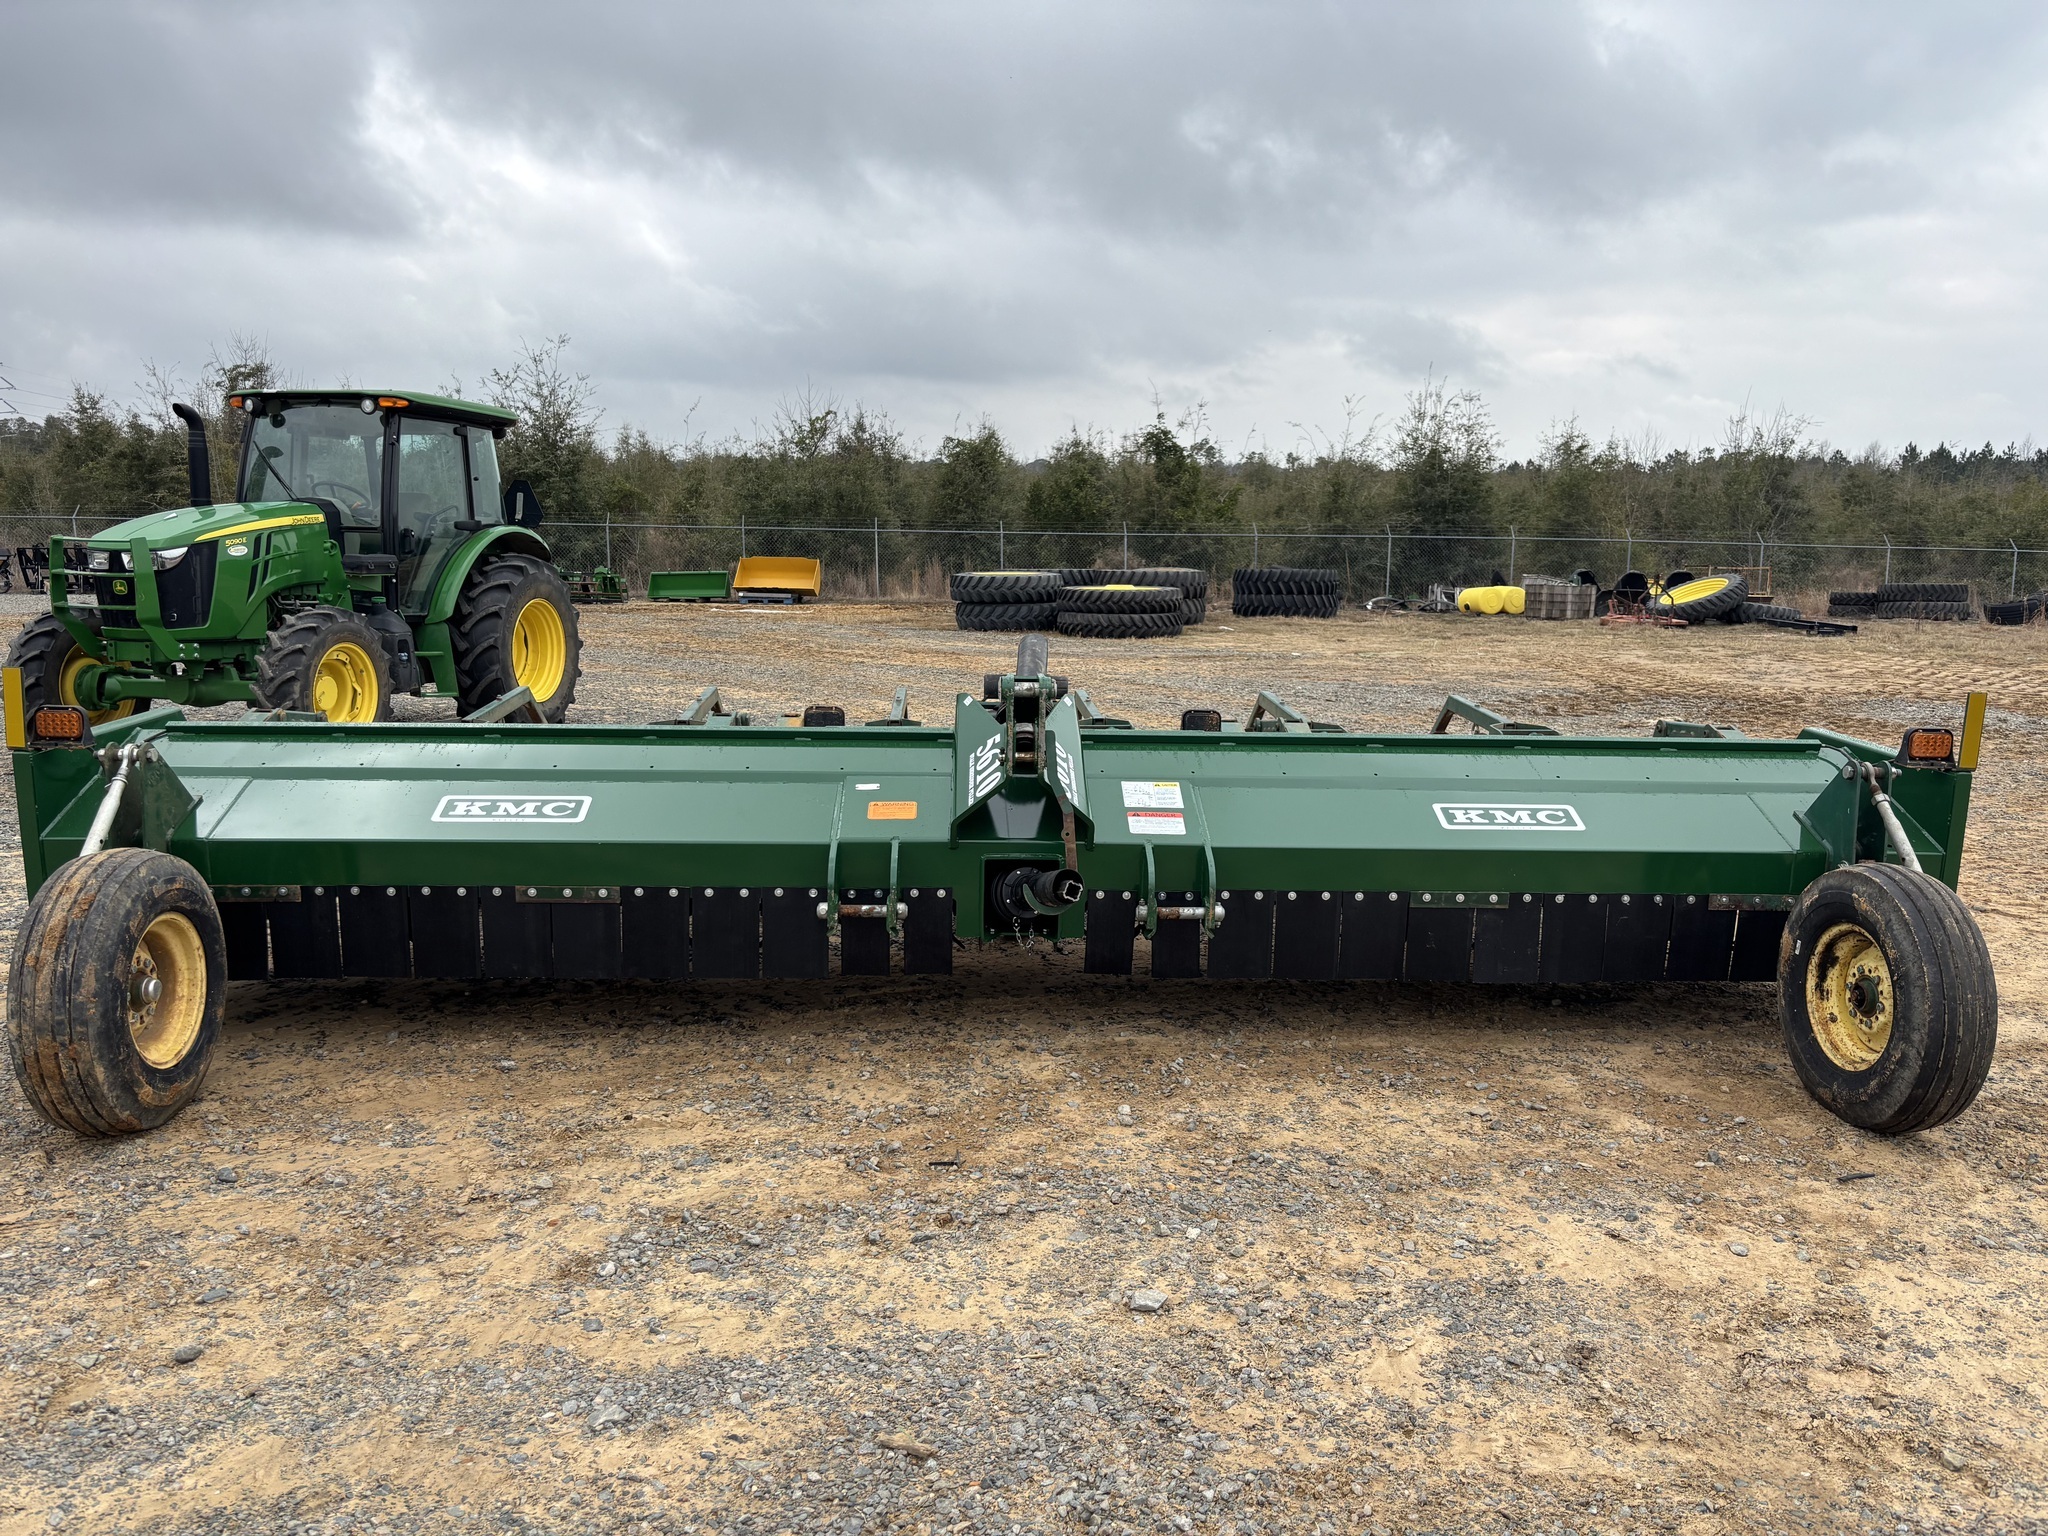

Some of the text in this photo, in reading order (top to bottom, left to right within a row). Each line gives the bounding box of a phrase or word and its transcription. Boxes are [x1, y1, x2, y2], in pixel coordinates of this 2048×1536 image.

[976, 733, 1001, 798] 5610
[448, 801, 576, 816] KMC
[1448, 809, 1567, 824] KMC
